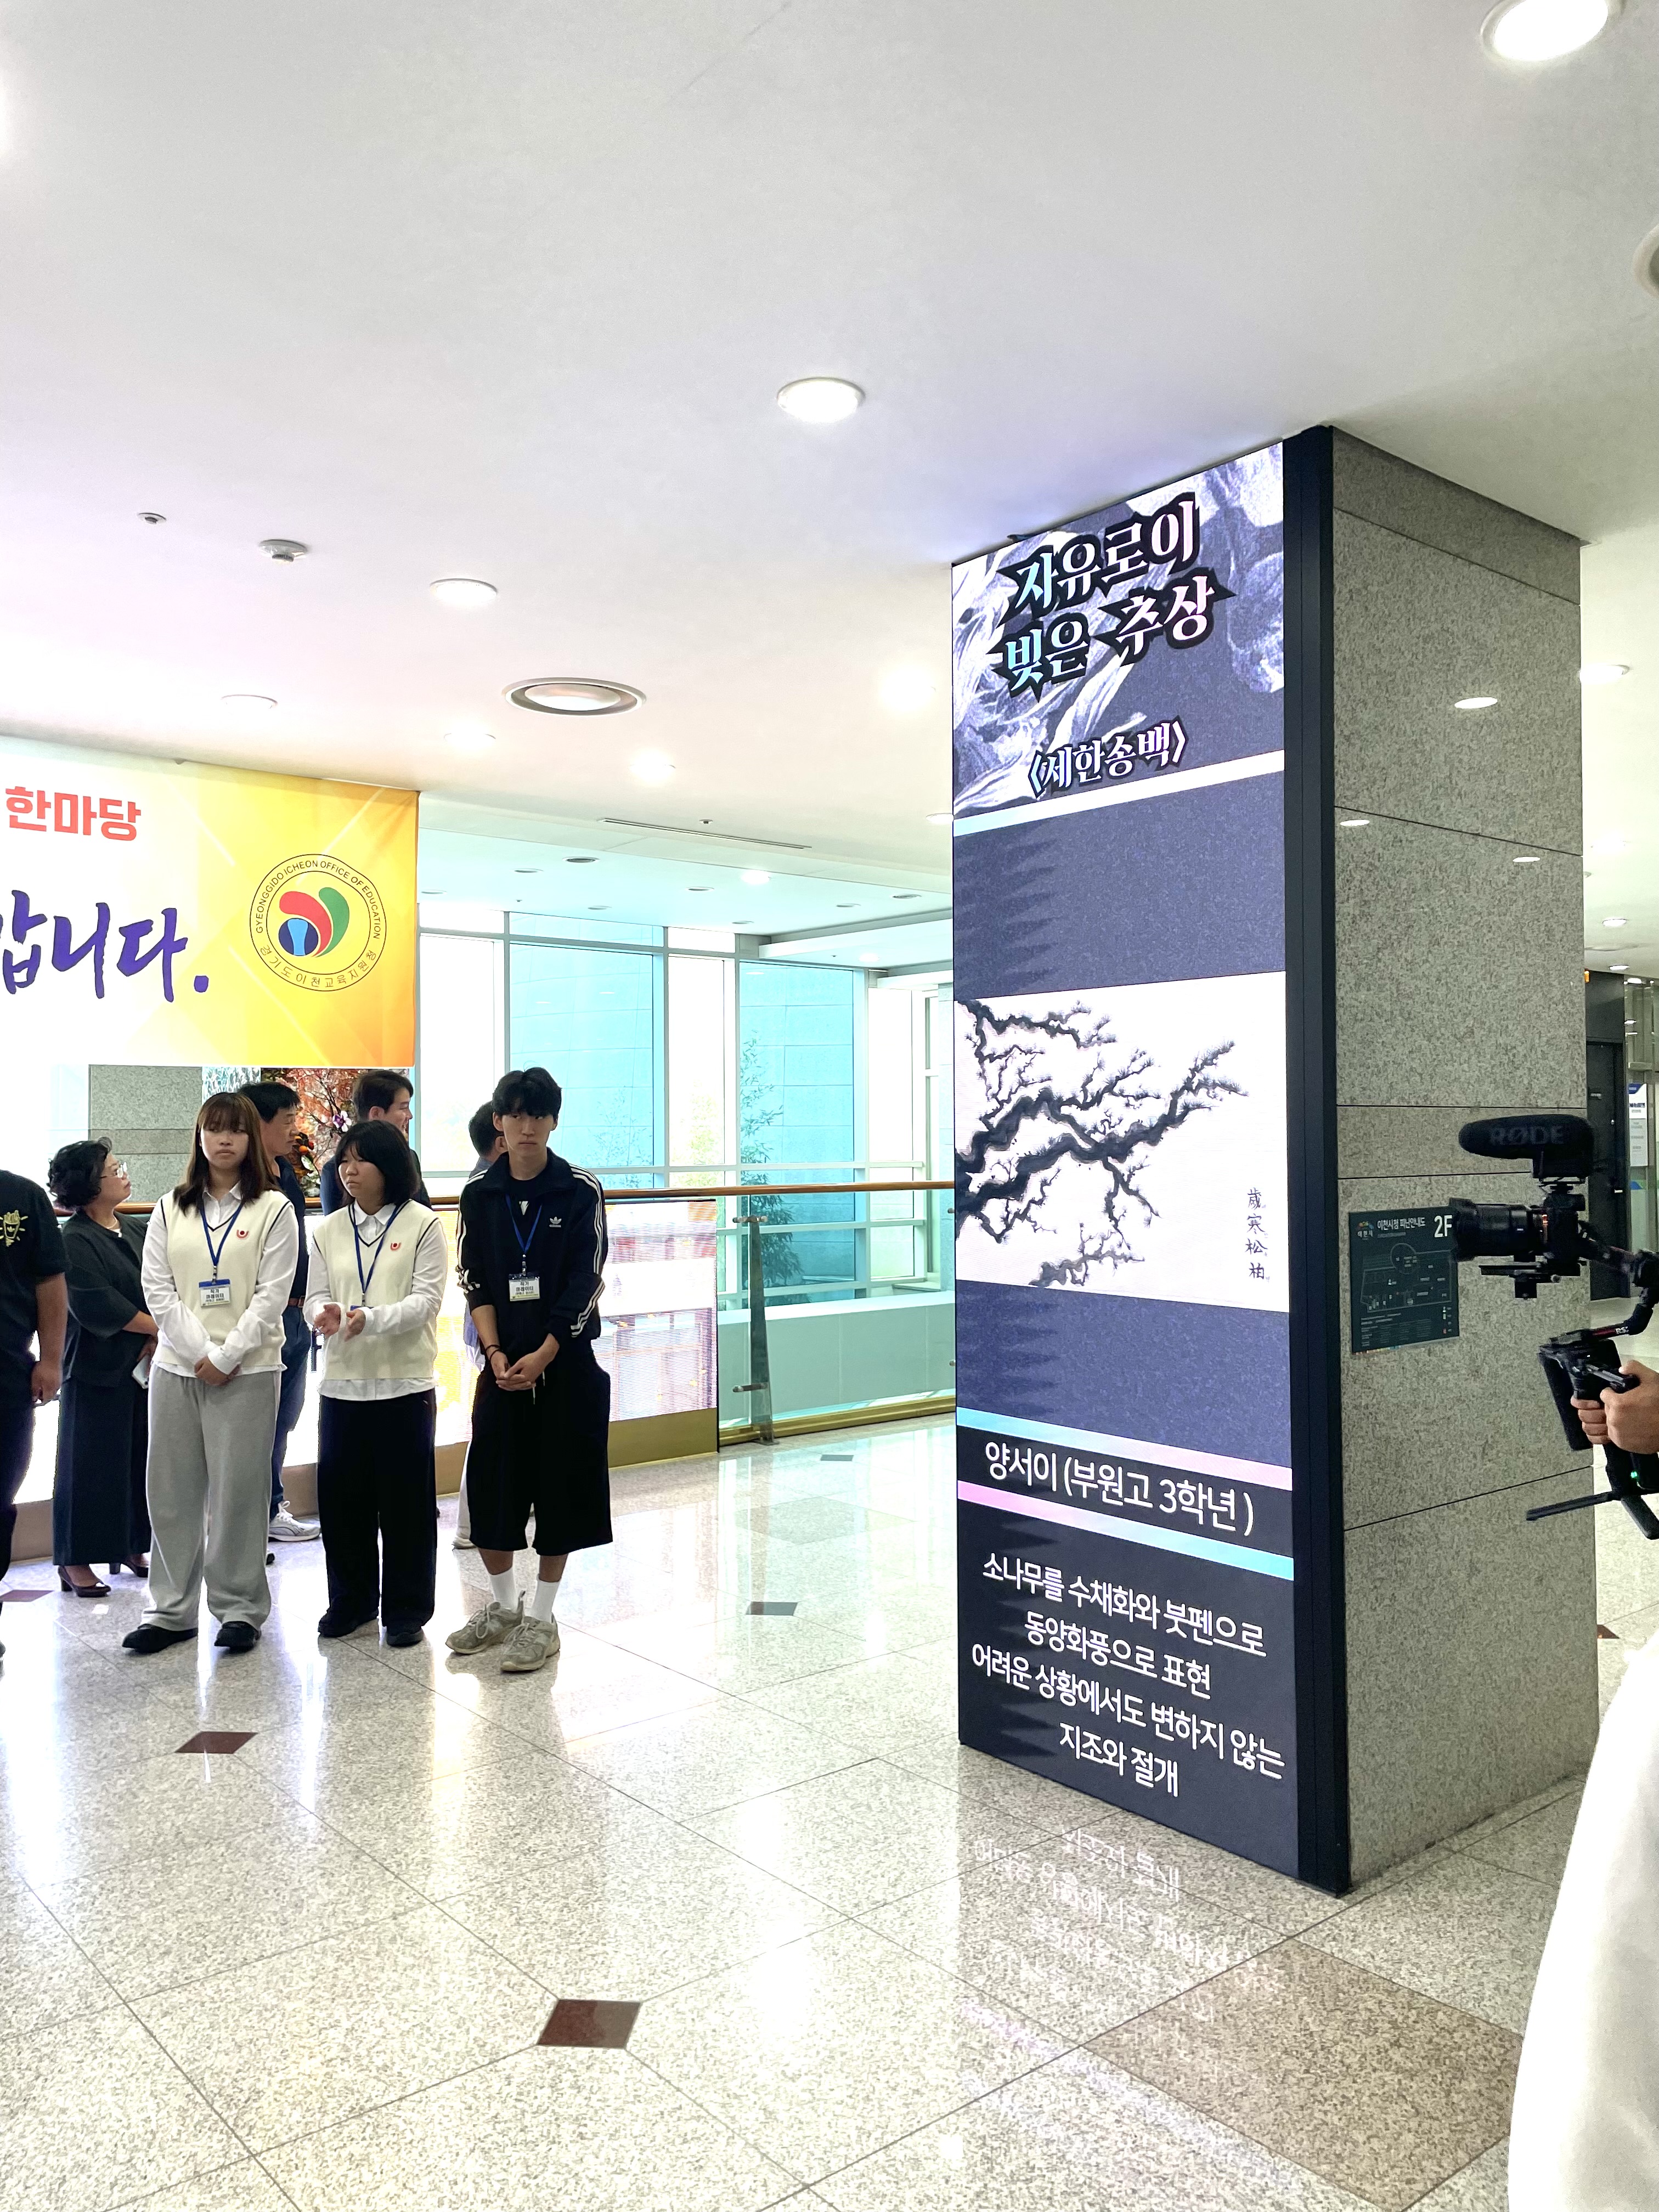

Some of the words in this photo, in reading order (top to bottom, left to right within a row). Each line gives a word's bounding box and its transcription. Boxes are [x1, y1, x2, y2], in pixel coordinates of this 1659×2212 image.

[1015, 500, 1194, 609] 자유로이
[1005, 620, 1088, 691] 빚은
[1115, 575, 1215, 656] 추상
[5, 786, 142, 841] 한마당
[256, 872, 284, 934] GYEONGGIDO
[283, 860, 318, 876] ICHEON
[320, 860, 351, 879] OFFICE
[351, 876, 364, 886] OF
[361, 885, 381, 939] EDUCATION
[1434, 1215, 1453, 1238] 2F
[985, 1442, 1057, 1492] 양서이
[1064, 1457, 1153, 1508] (부원고
[983, 1553, 1065, 1602] 소나무를
[1068, 1576, 1161, 1630] 수채화와
[1163, 1599, 1267, 1657] 붓펜으로
[1024, 1611, 1158, 1678] 동양화풍으로
[1161, 1654, 1210, 1700] 표현
[972, 1644, 1032, 1690] 어려운
[1035, 1664, 1147, 1727] 상황에서도
[1151, 1702, 1224, 1759] 변하지
[1230, 1730, 1285, 1779] 않는
[1059, 1722, 1127, 1776] 지조와
[1131, 1747, 1178, 1797] 절개
